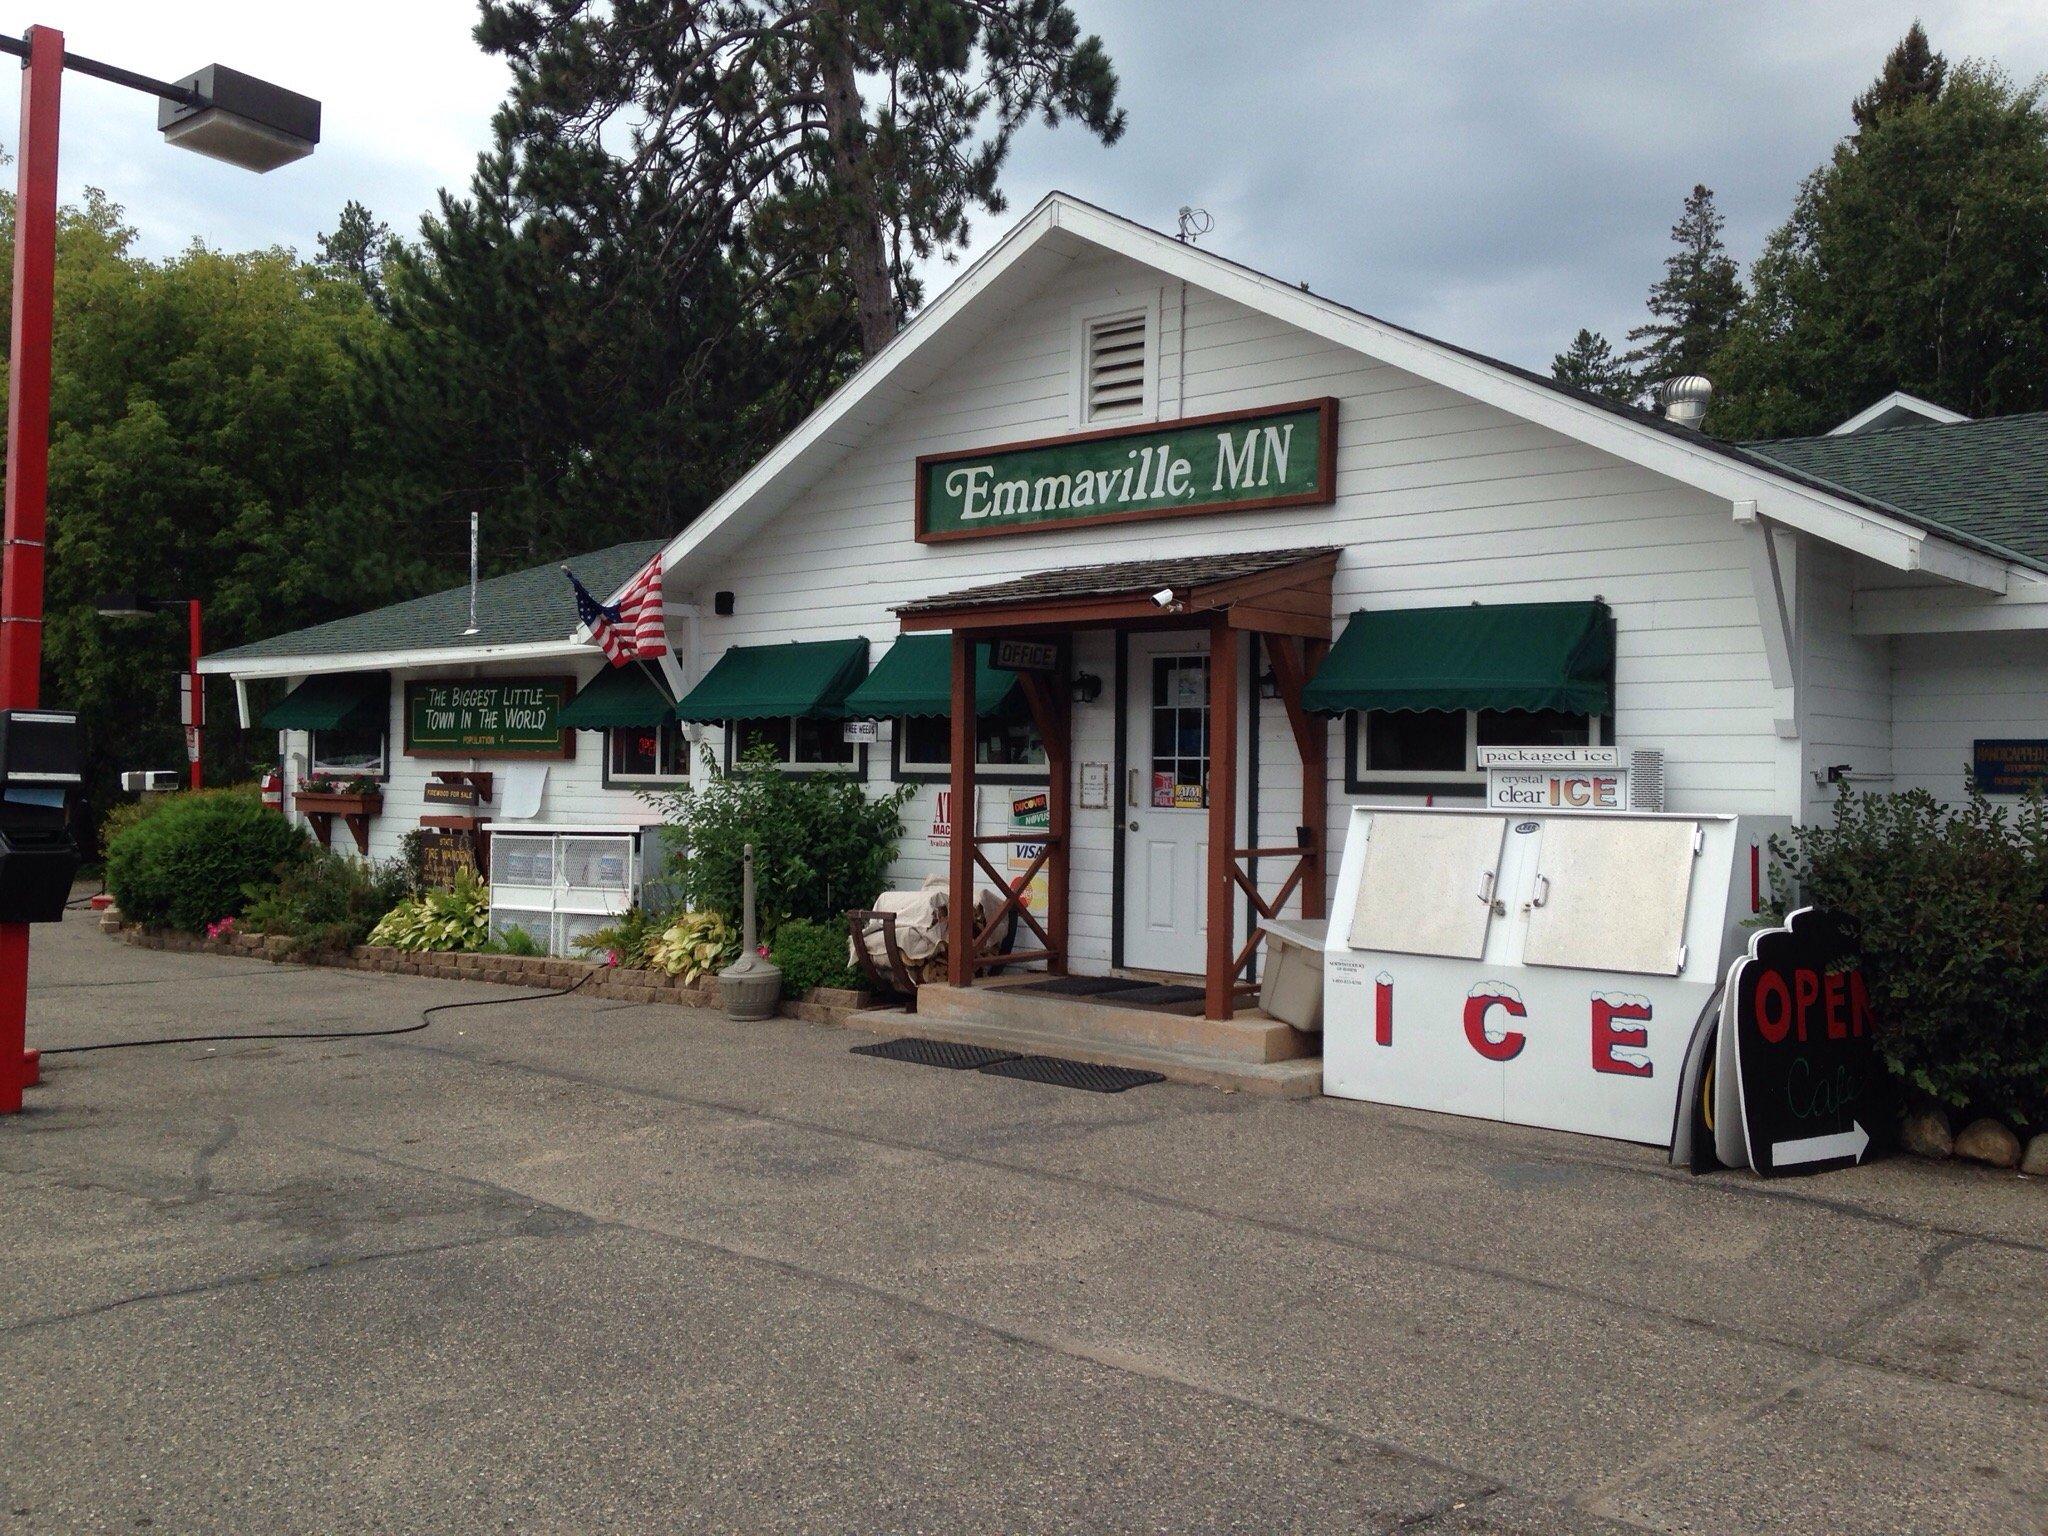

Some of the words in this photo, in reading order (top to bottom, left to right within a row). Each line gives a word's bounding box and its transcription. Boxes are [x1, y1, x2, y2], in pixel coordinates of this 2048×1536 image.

[945, 445, 1197, 520] Emmaville,
[1212, 423, 1295, 491] MN
[1002, 645, 1053, 665] OFFICE
[451, 687, 498, 707] BIGGEST
[502, 686, 544, 706] LITTLE
[425, 708, 456, 731] TOWN
[460, 709, 472, 729] IN
[478, 708, 498, 729] THE
[462, 735, 495, 745] POPULATION
[1484, 750, 1581, 763] packaged
[1584, 750, 1613, 762] ice
[1177, 785, 1200, 798] ATM
[1498, 785, 1546, 804] clear
[1501, 774, 1544, 786] crystal
[1549, 772, 1618, 808] ICE
[1154, 797, 1174, 805] PULL
